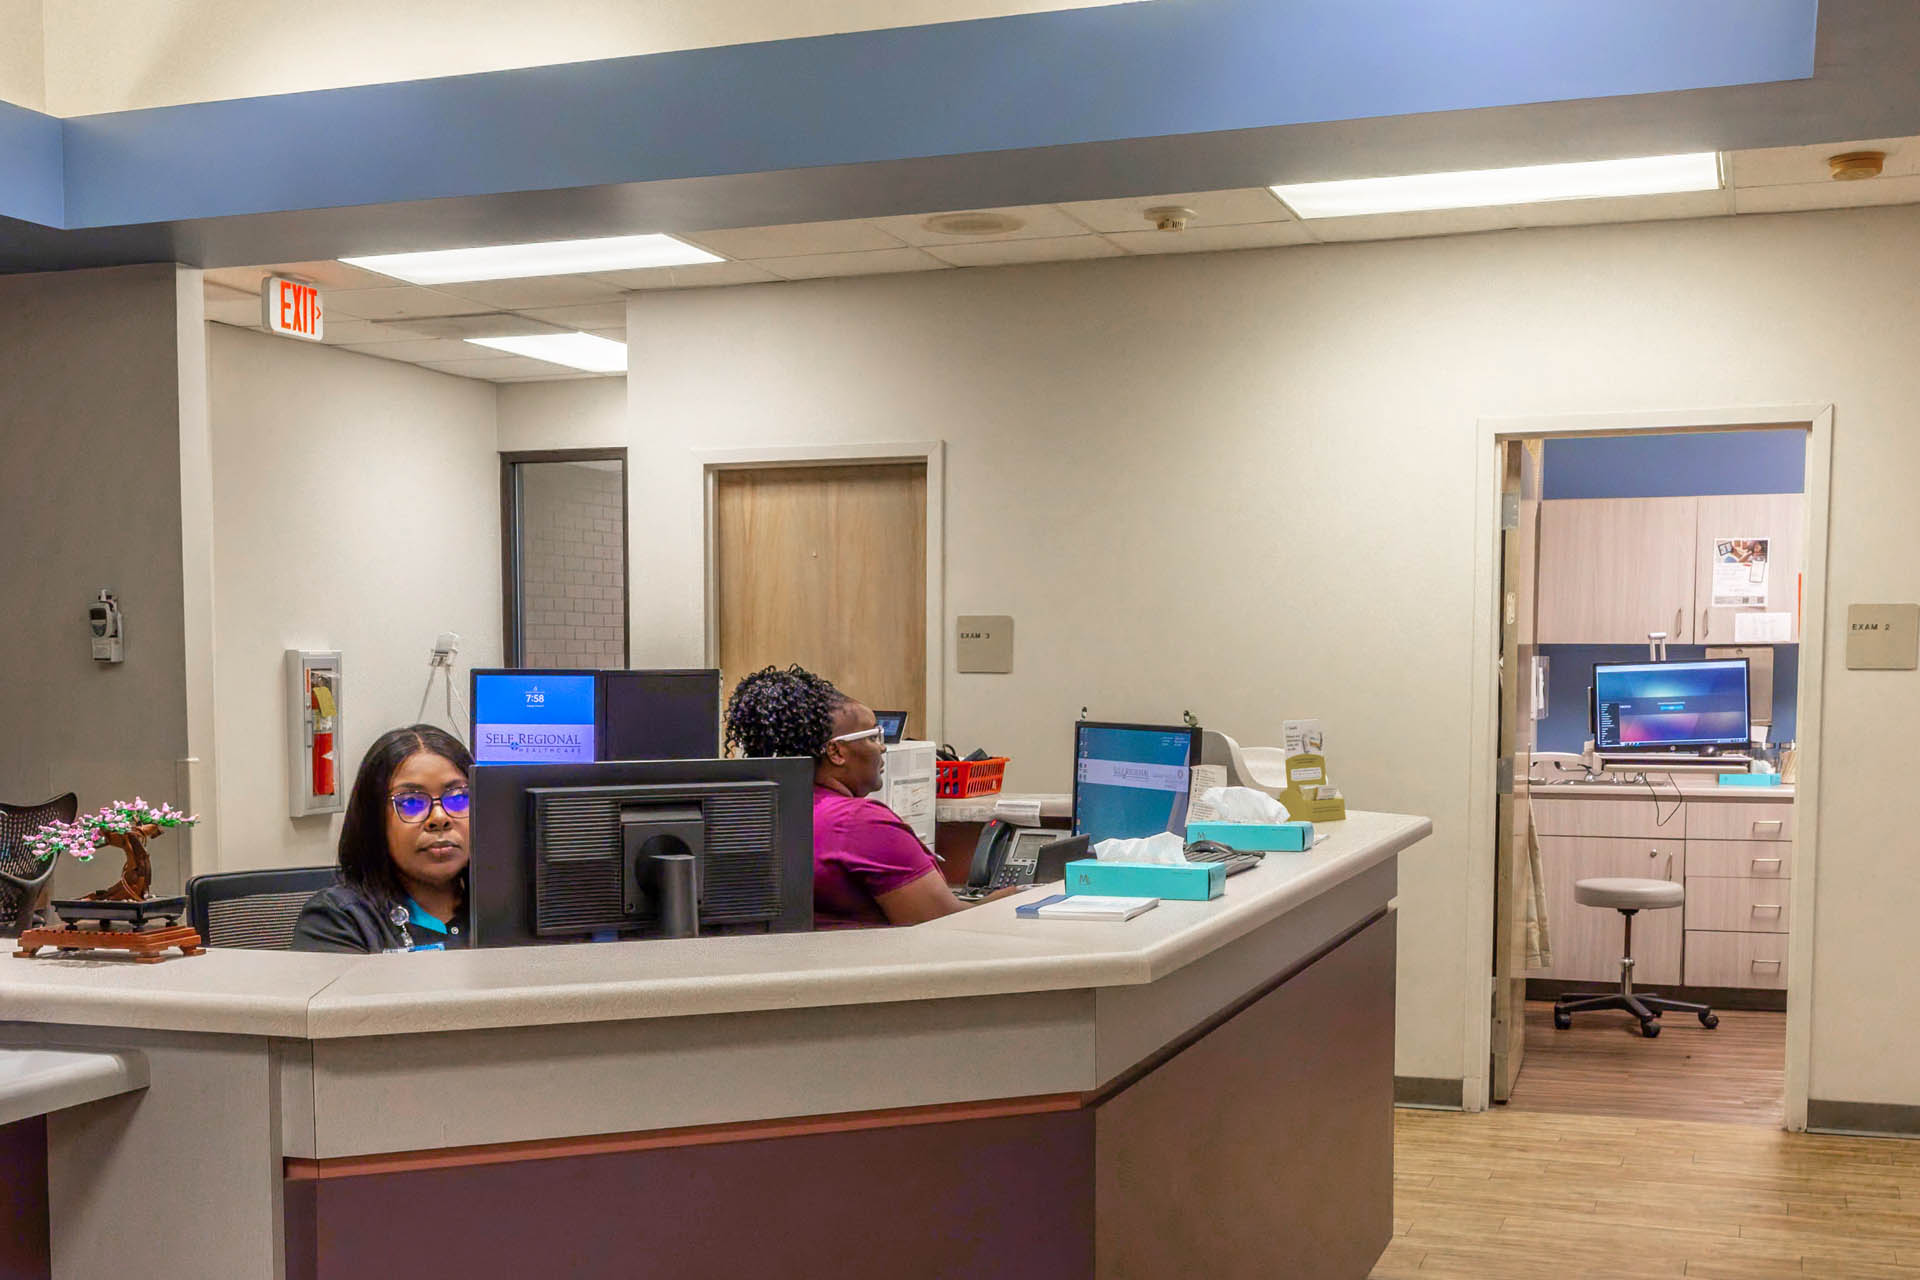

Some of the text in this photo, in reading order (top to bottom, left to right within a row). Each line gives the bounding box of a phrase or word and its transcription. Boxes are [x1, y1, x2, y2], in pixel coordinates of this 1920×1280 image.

[280, 280, 318, 335] EXIT
[1851, 623, 1890, 631] EXAM 2
[525, 694, 545, 703] 7:58
[485, 732, 582, 745] SELF REGIONAL
